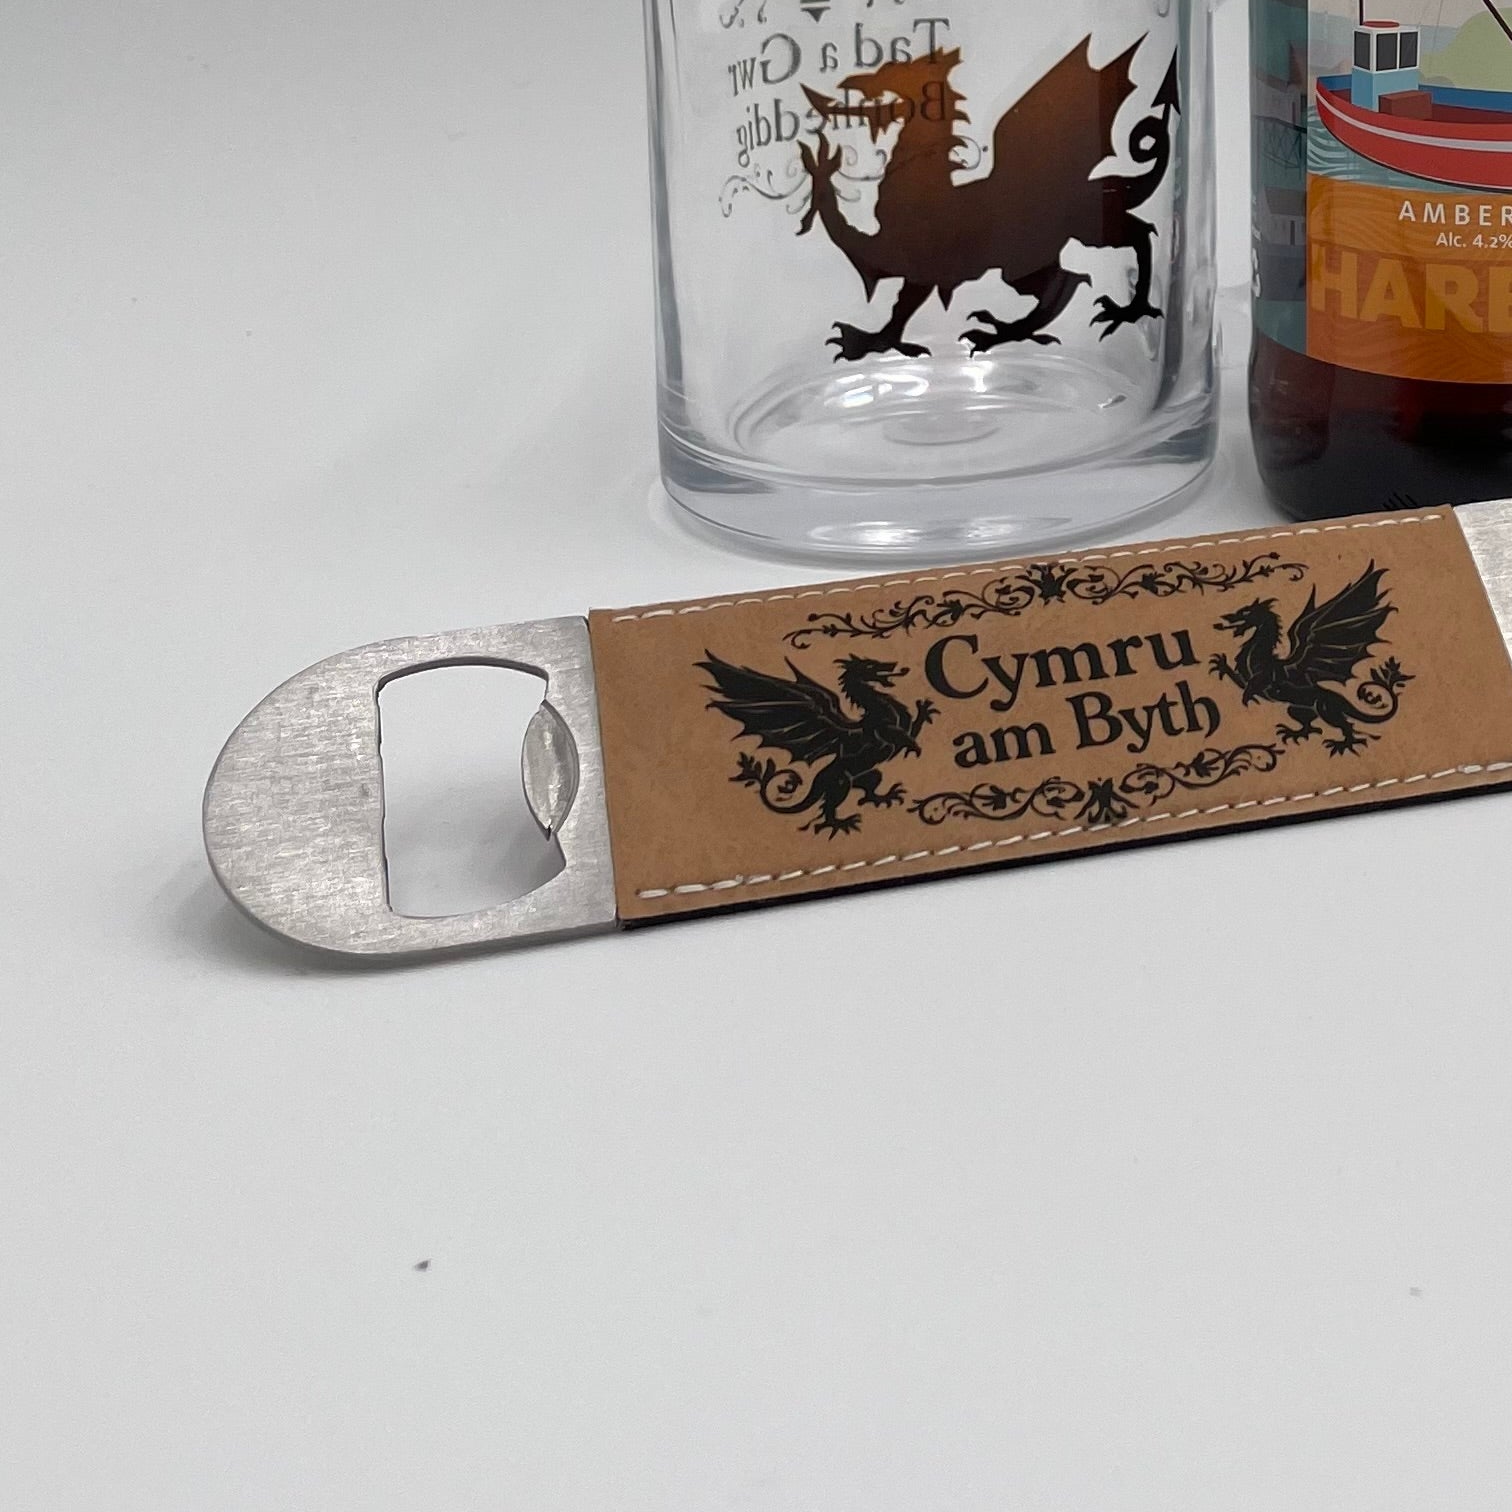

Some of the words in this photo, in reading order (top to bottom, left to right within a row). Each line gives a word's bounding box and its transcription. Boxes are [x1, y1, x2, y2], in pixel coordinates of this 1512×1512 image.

[1435, 231, 1467, 249] Alc.
[924, 628, 1202, 712] Cymru
[952, 720, 1057, 769] am
[1065, 679, 1221, 754] Byth
